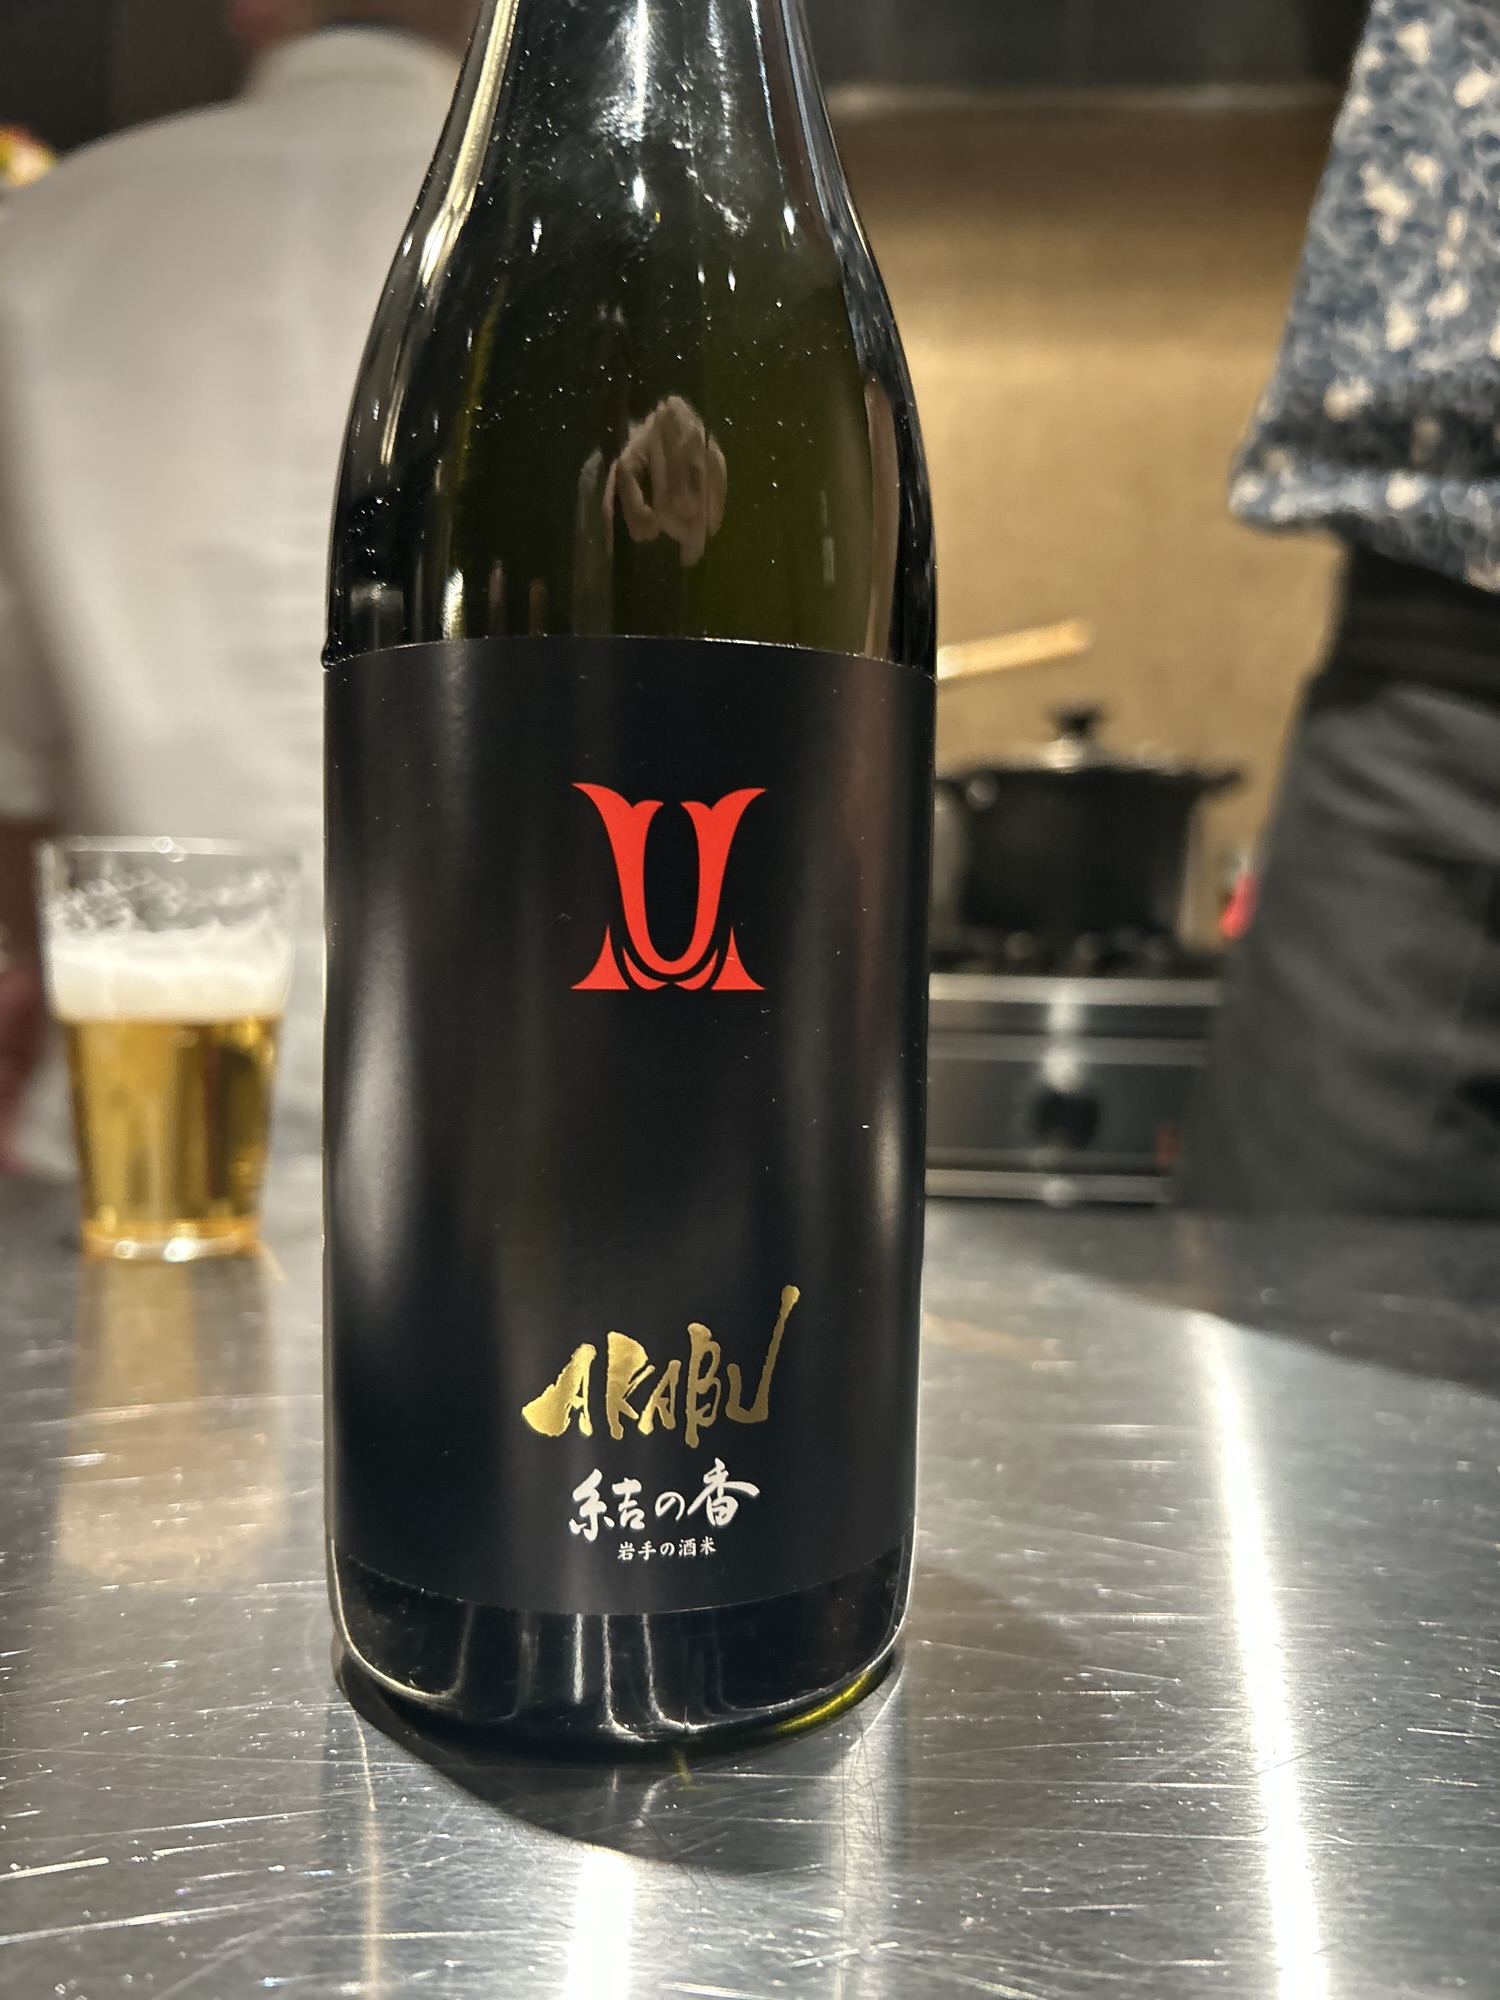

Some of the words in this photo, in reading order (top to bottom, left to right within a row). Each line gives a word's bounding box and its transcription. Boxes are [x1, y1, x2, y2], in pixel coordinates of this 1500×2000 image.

[521, 1284, 800, 1448] AKABU
[568, 1457, 760, 1541] 結の香
[617, 1536, 717, 1561] 岩手の酒米
